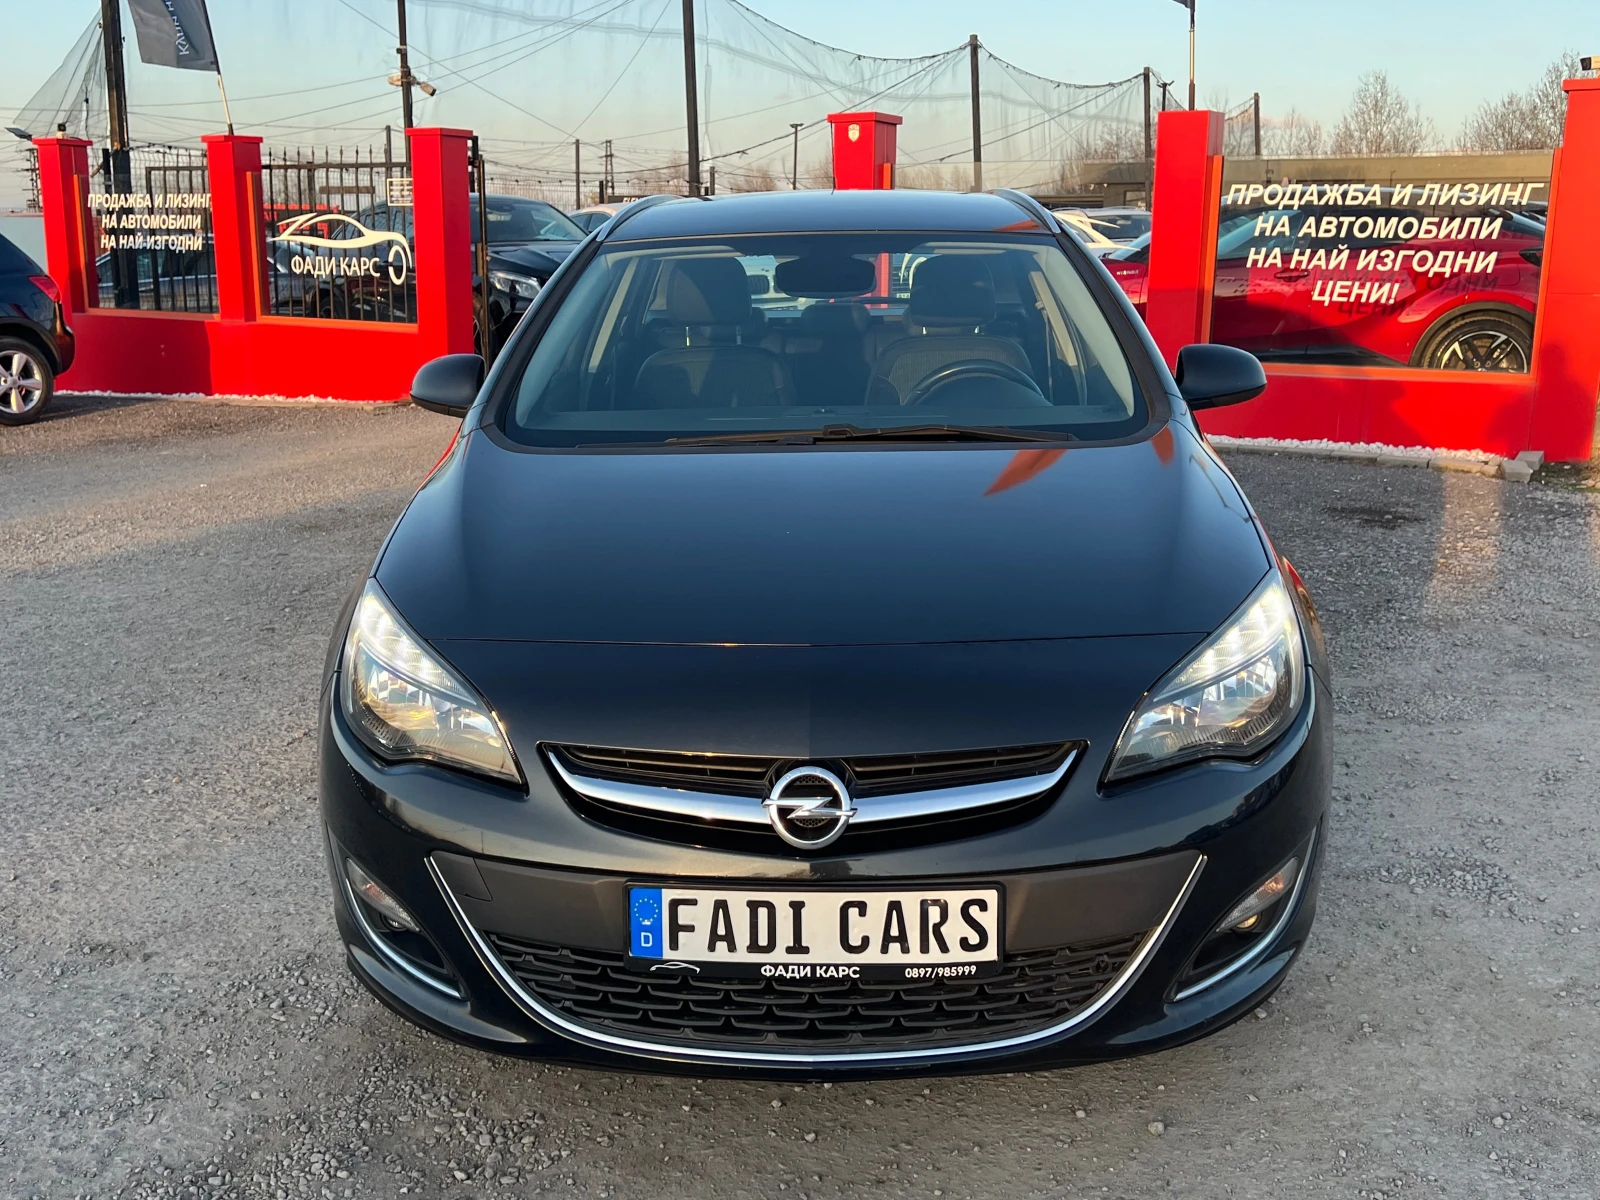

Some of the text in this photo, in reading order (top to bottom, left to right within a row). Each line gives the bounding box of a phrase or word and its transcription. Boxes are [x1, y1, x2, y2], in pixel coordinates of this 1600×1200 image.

[87, 193, 212, 211] ПРОДАЖБА И ЛИЗИНГ
[1227, 183, 1545, 210] ПРОДАЖБА И ЛИЗИНГ
[101, 214, 202, 230] НА АВТОМОБИЛИ
[1254, 215, 1503, 240] НА АВТОМОБИЛИ
[100, 234, 116, 249] НА
[146, 235, 202, 254] ИЗГОДНИ
[291, 255, 381, 279] ФАДИ КАРС
[1246, 244, 1498, 277] НА НАЙ ИЗГОДНИ
[1311, 281, 1400, 306] ЦЕНИ!
[668, 898, 989, 955] FADI CARS
[640, 932, 653, 947] D
[760, 964, 860, 979] ФАДИ КАРС
[904, 965, 977, 979] 0897/985999
